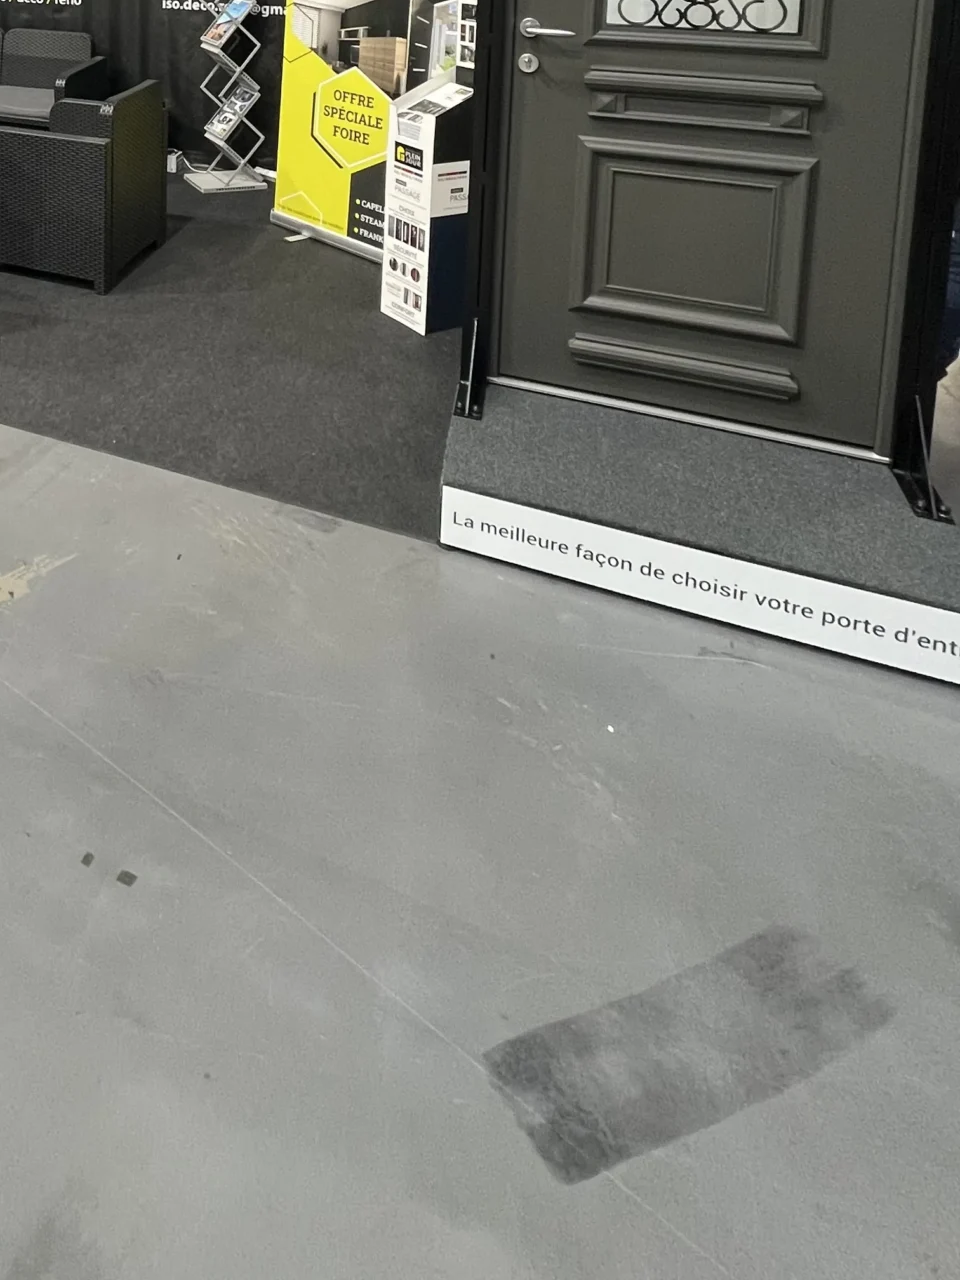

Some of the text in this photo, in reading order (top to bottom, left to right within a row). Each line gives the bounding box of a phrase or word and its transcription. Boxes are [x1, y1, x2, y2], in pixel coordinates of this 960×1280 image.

[334, 89, 374, 109] OFFRE
[323, 105, 383, 130] SPÉCIALE
[333, 128, 370, 146] FOIRE
[405, 151, 421, 161] PLEIN
[449, 193, 467, 203] PASS
[452, 510, 474, 529] La
[480, 519, 569, 554] meilleure
[576, 543, 632, 572] façon
[640, 561, 665, 580] de
[672, 569, 747, 601] choisir
[755, 593, 814, 618] votre
[822, 609, 886, 638] porte
